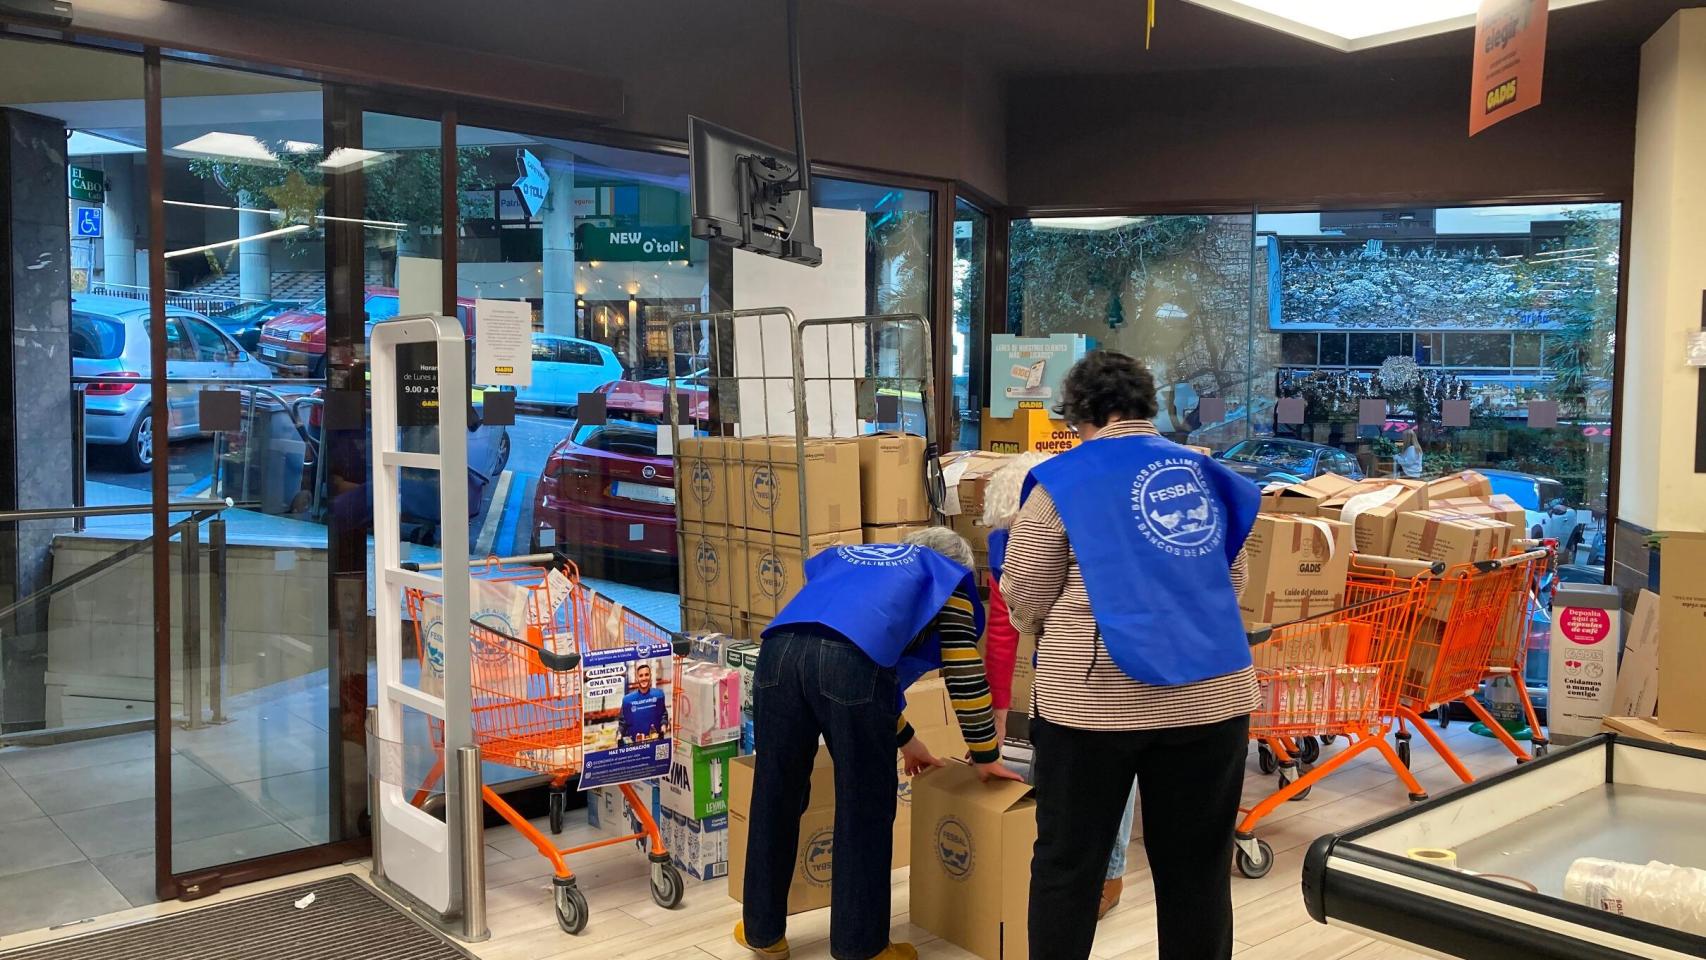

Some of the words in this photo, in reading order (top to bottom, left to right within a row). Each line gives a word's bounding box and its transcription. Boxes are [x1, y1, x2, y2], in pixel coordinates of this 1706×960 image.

[1487, 80, 1516, 110] GADIS
[72, 167, 84, 179] EL
[72, 178, 102, 192] CABO
[609, 232, 641, 244] NEW
[1036, 440, 1072, 450] queres
[1148, 460, 1162, 471] DE
[1149, 482, 1200, 503] FESBAL
[860, 556, 914, 567] ALIMENTOS
[1300, 563, 1321, 573] GADIS
[1309, 588, 1328, 598] planeta
[1569, 609, 1601, 617] Deposita
[588, 666, 624, 677] ALIMENTA
[1565, 678, 1602, 686] Coidamos
[590, 688, 613, 697] MEJOR
[1573, 684, 1600, 692] mundo
[1567, 690, 1597, 698] contigo
[625, 743, 650, 753] DONACIÓN
